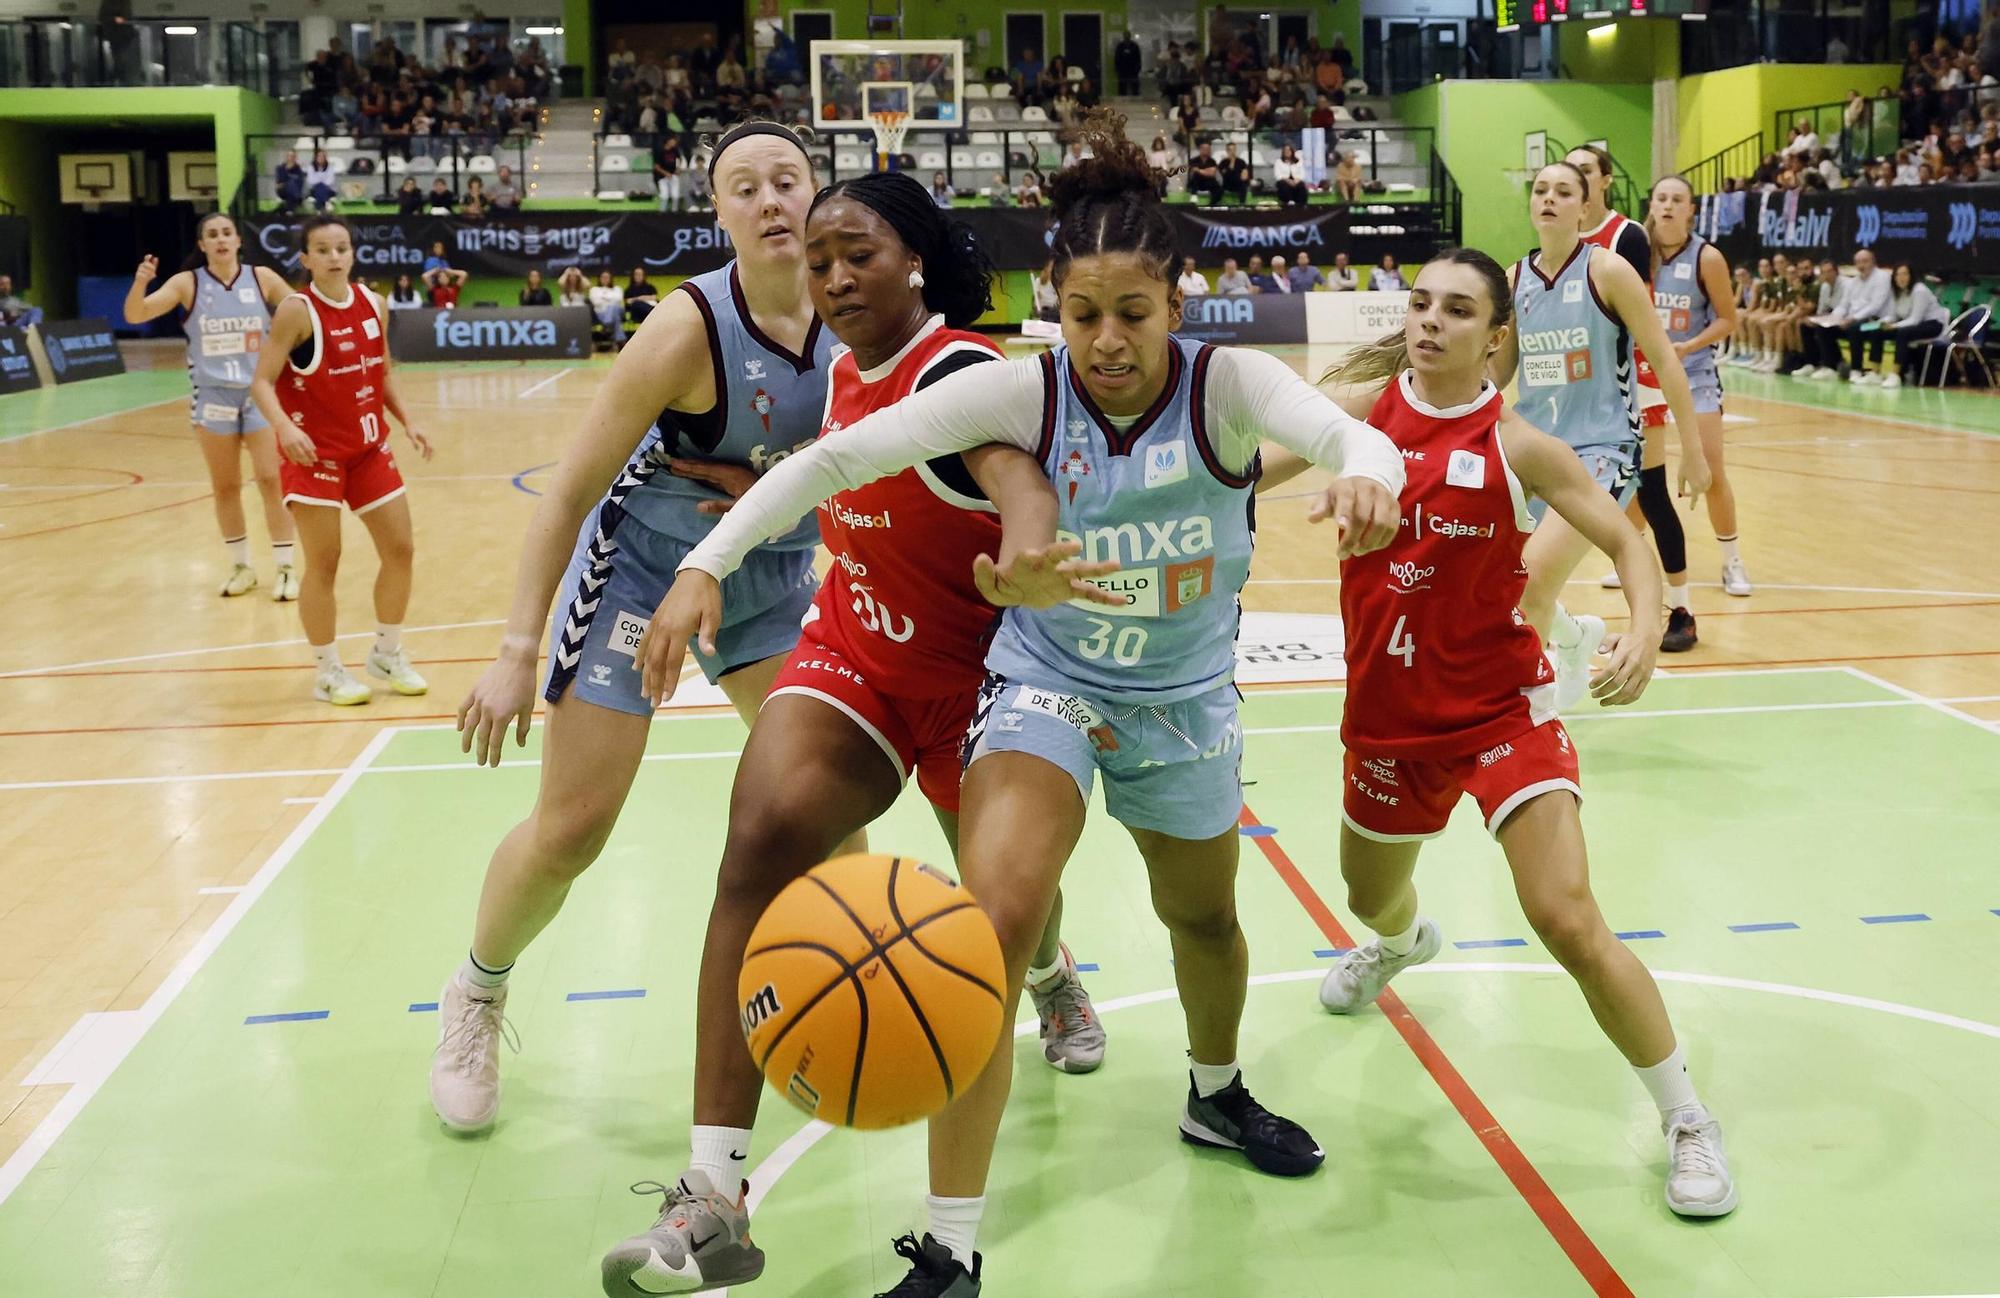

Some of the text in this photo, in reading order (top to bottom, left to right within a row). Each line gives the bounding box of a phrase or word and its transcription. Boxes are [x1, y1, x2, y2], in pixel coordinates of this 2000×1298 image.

[356, 245, 423, 264] Celta
[1654, 291, 1691, 308] mxa
[199, 315, 262, 333] femxa
[434, 311, 557, 347] femxa
[1368, 317, 1384, 327] DE
[224, 360, 241, 380] 11
[1530, 370, 1559, 380] DE VIGO
[360, 412, 379, 444] 10
[836, 506, 892, 530] Cajasol
[1428, 514, 1495, 539] Cajasol
[1056, 515, 1215, 567] emxa
[1078, 617, 1149, 666] 30
[1387, 615, 1416, 668] 4
[797, 660, 864, 685] KELME
[1031, 694, 1082, 730] DE VIGO
[1480, 743, 1514, 764] SEVILLA
[1361, 759, 1396, 779] aleppo
[1351, 773, 1400, 806] KELME
